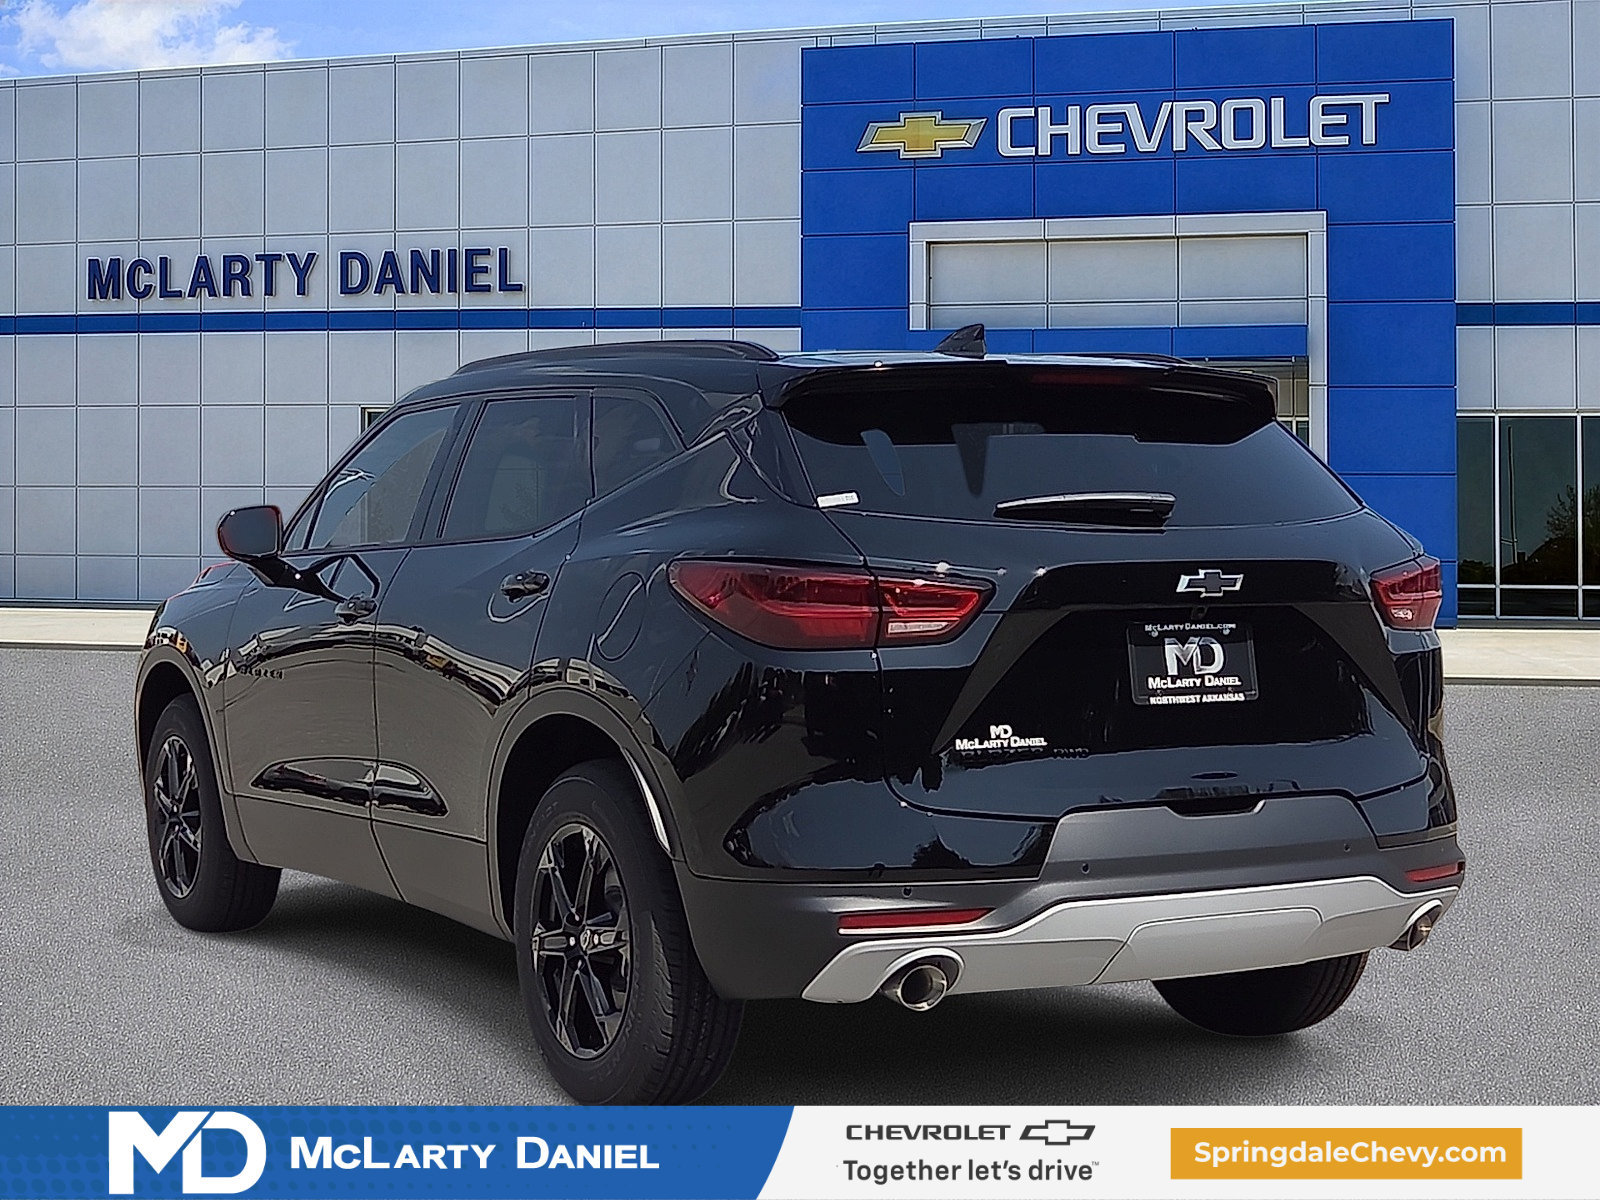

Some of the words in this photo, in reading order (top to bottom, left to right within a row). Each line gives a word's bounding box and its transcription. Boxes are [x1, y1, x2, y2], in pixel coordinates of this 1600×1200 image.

[997, 93, 1390, 158] CHEVROLET
[339, 246, 525, 296] DANIEL
[1164, 637, 1224, 675] MD
[1204, 675, 1242, 686] DANIEL
